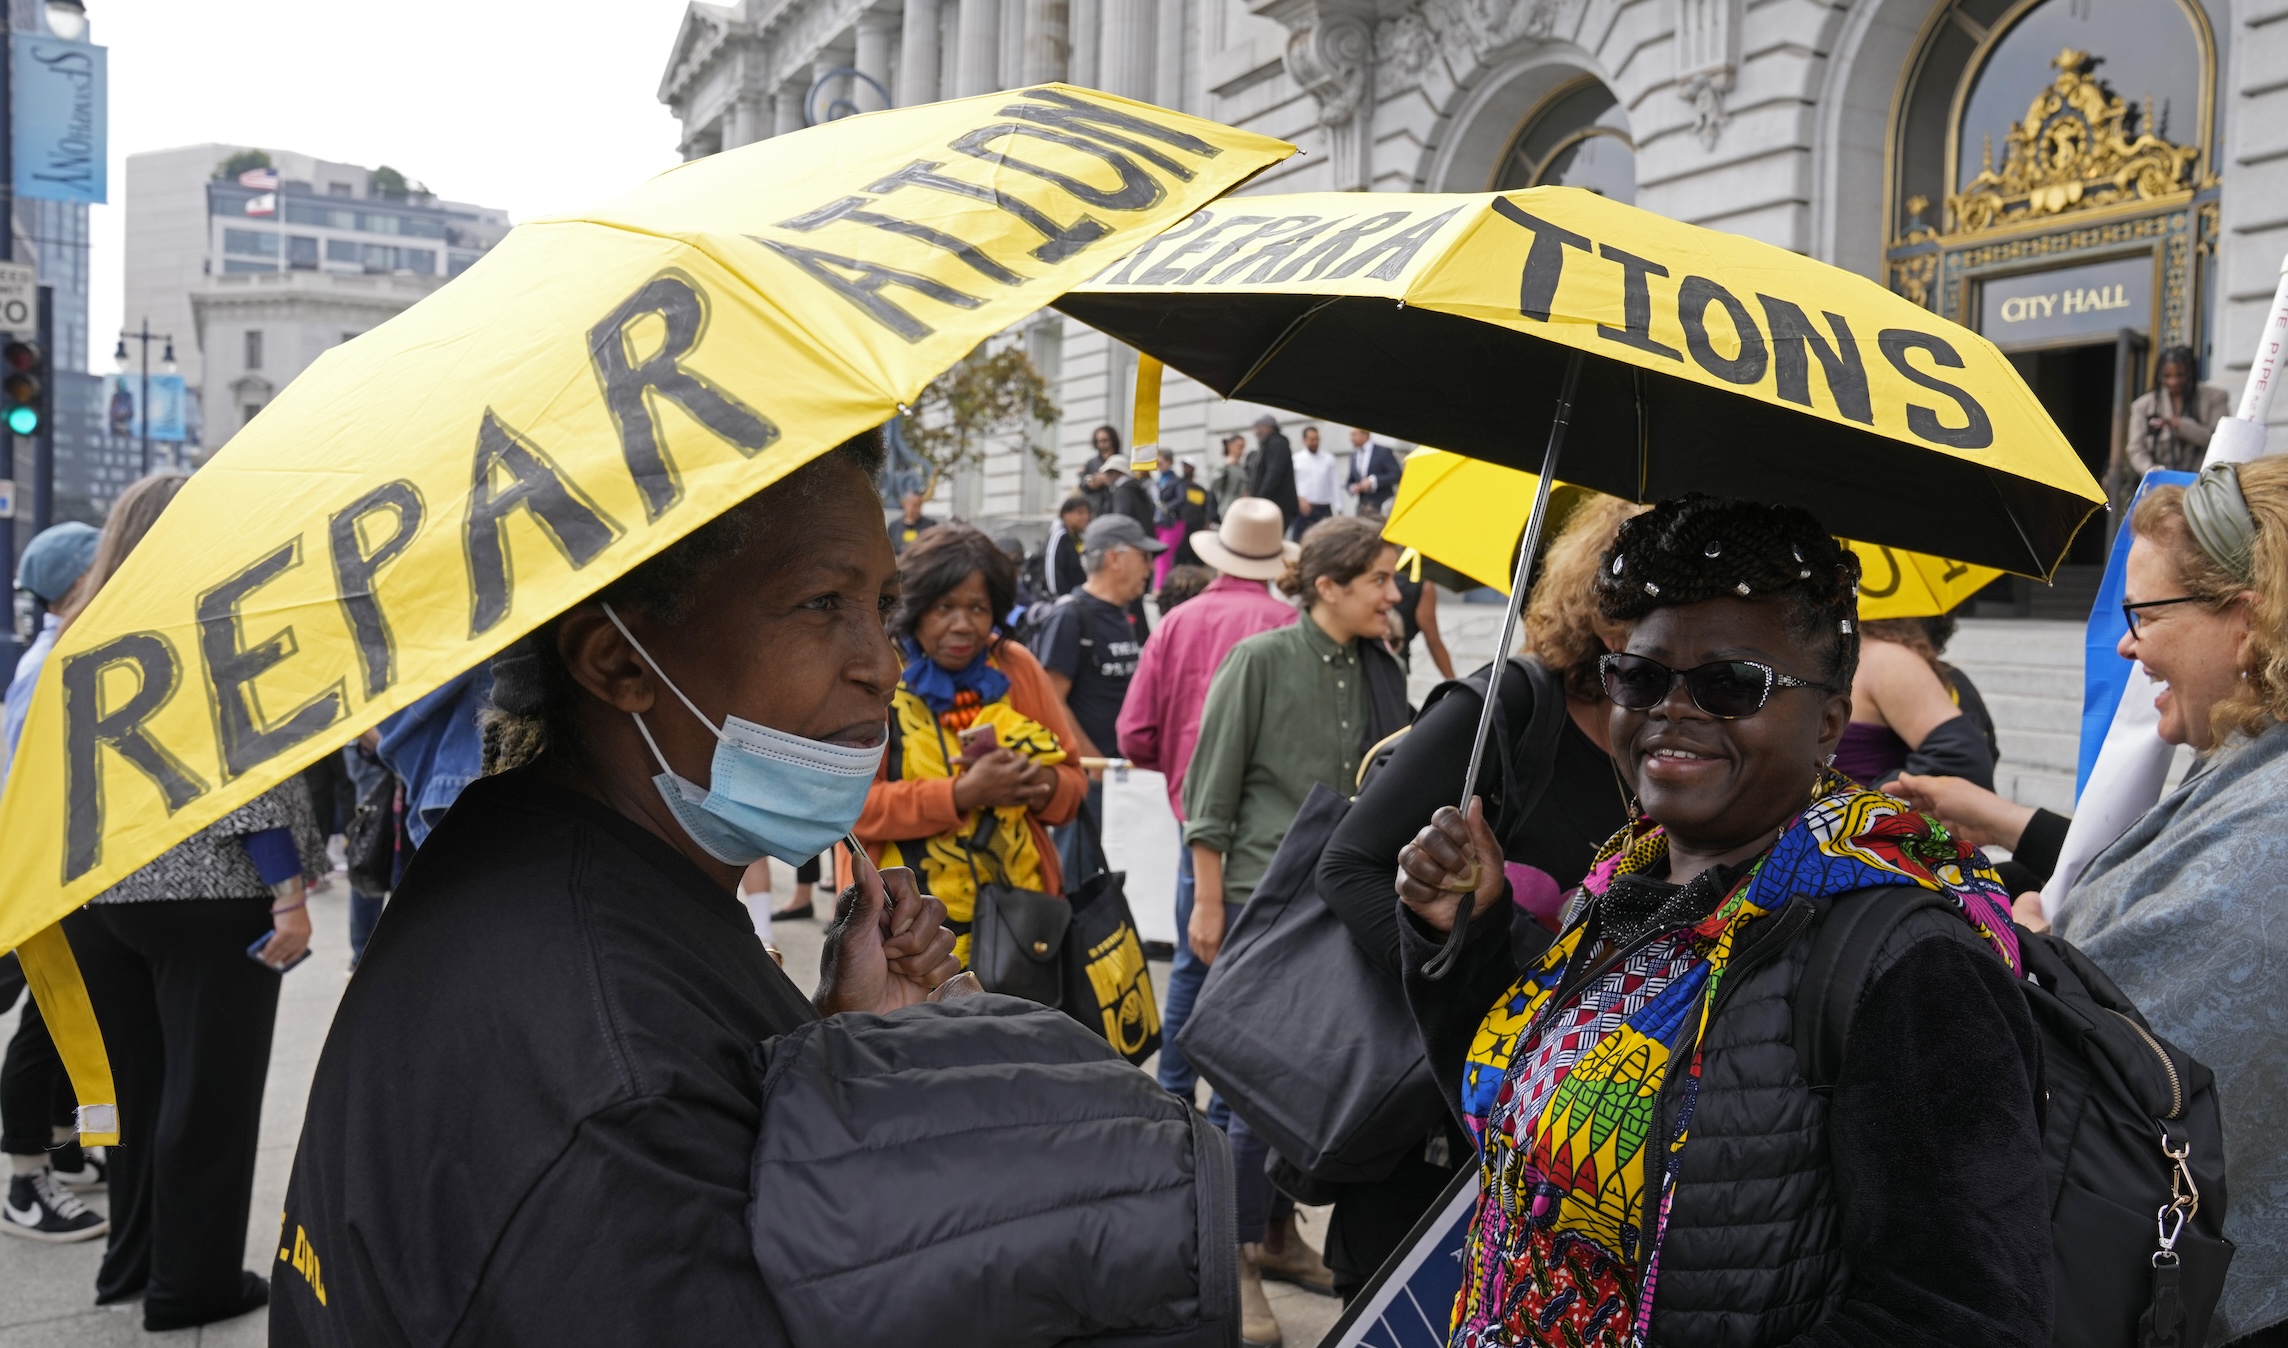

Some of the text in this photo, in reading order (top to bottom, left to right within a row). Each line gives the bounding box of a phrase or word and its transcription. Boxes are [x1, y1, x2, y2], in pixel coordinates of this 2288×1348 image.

[2001, 283, 2131, 323] CITY HALL
[2255, 341, 2280, 392] PIPE
